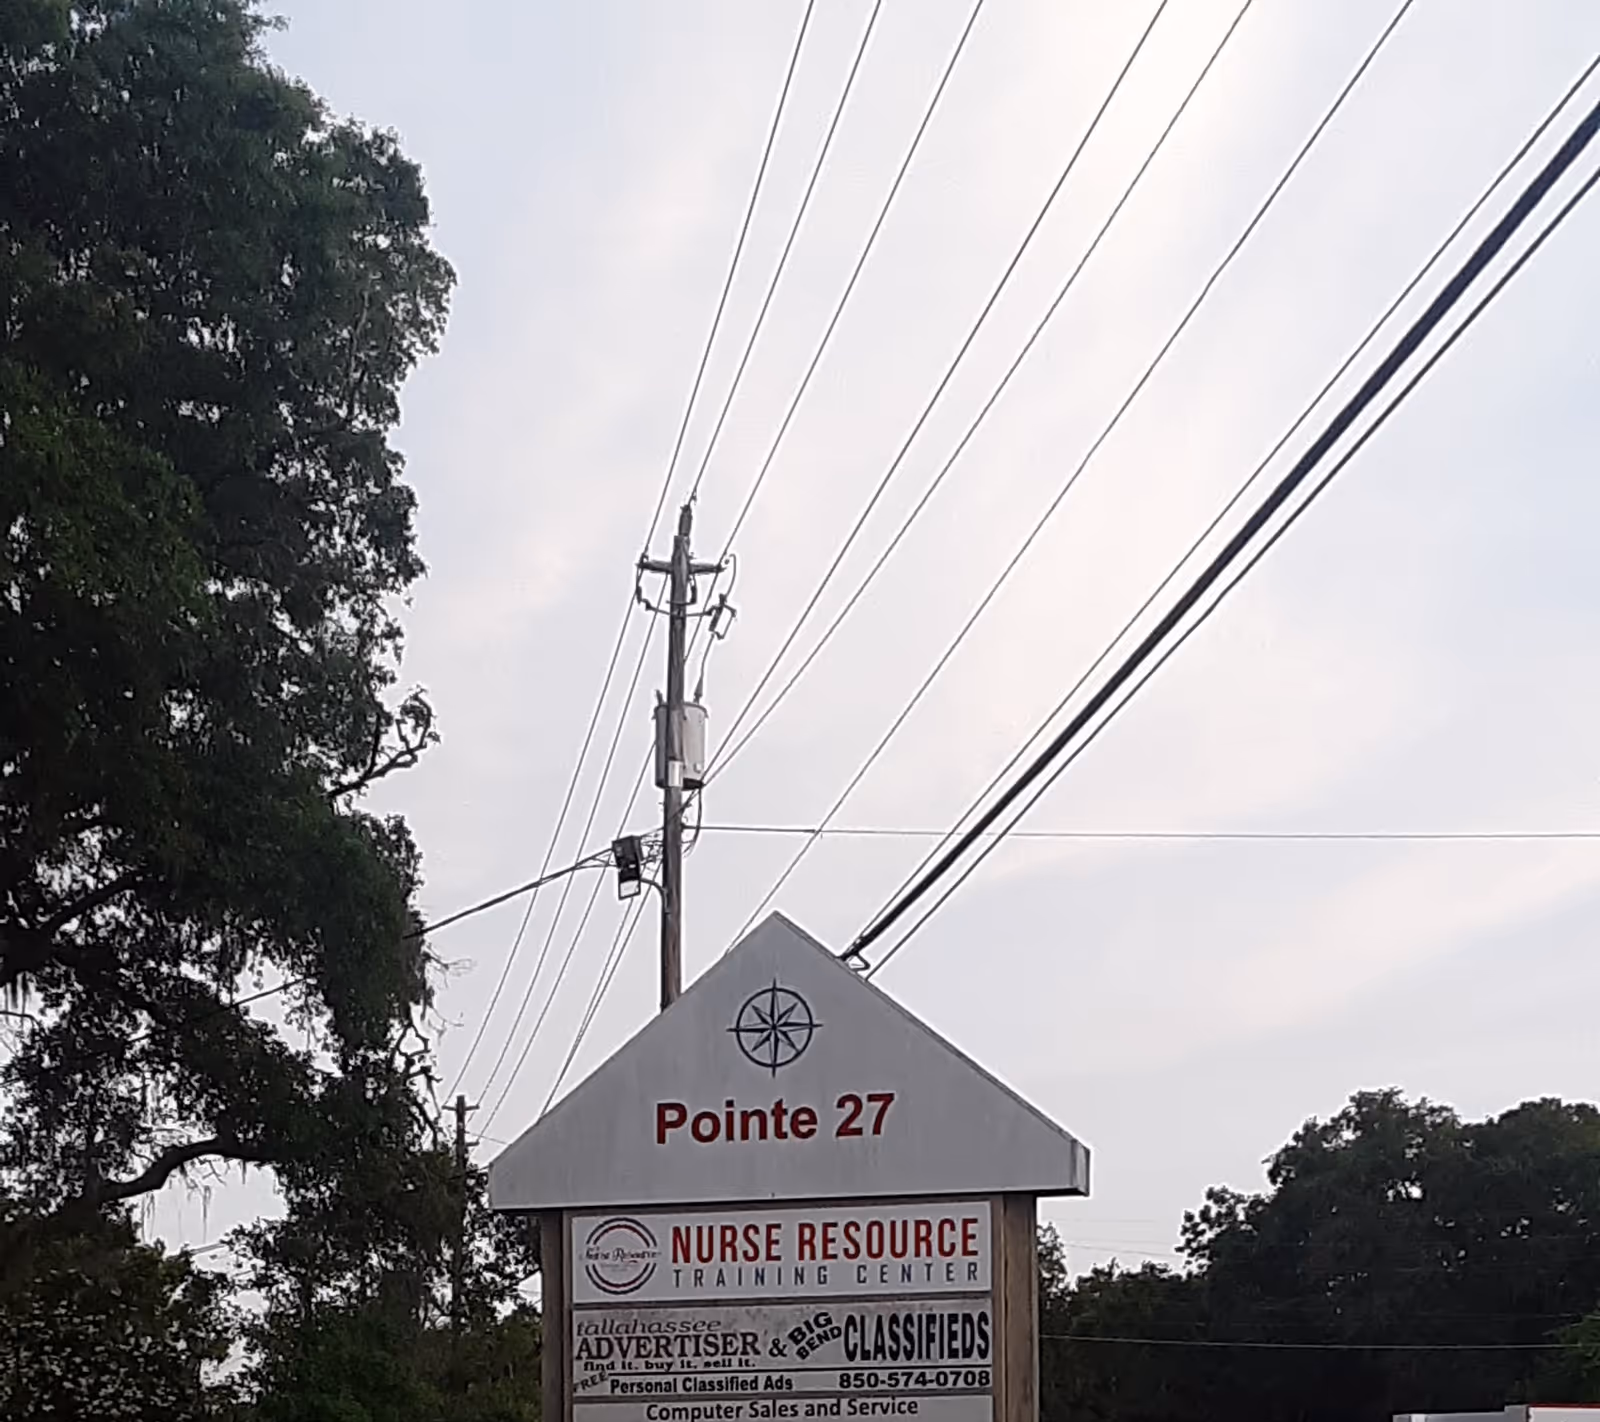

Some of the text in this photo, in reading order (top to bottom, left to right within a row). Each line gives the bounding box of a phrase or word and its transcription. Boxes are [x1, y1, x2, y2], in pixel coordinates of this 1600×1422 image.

[656, 1093, 895, 1144] Pointe 27
[671, 1223, 782, 1264] NURSE
[798, 1218, 979, 1261] RESOURCE
[673, 1262, 978, 1288] TRAINING CENTER
[576, 1318, 722, 1336] tallahassee
[787, 1312, 833, 1346] BIG
[844, 1311, 989, 1362] CLASSIFIEDS
[575, 1332, 787, 1360] ADVERTISER &
[795, 1326, 842, 1360] BEND
[583, 1360, 615, 1372] find
[644, 1359, 674, 1373] buy
[704, 1358, 732, 1369] sell
[610, 1374, 793, 1394] Personal Classified Ads
[839, 1370, 990, 1389] 850-574-0708
[646, 1397, 918, 1422] Computer Sales and Service
